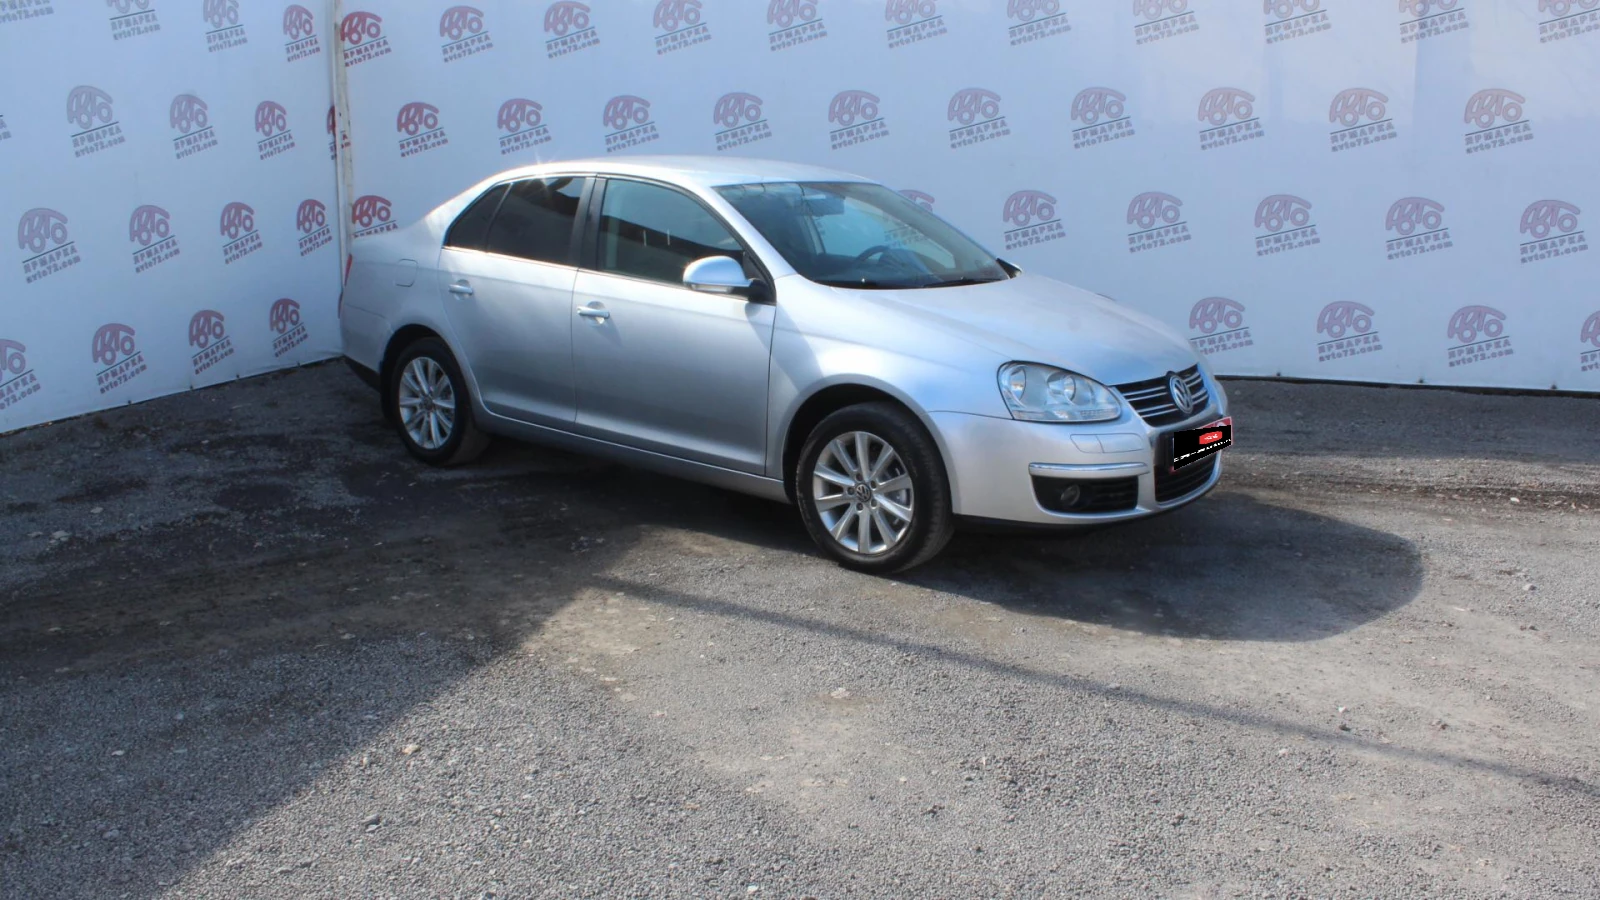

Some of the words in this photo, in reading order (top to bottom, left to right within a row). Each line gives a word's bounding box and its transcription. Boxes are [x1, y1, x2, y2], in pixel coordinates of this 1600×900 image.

[111, 13, 158, 31] ЯРМАРКА
[113, 24, 161, 41] avto72.com
[887, 18, 944, 41] ЯРМАРКА
[1009, 16, 1068, 38] ЯРМАРКА
[1135, 15, 1196, 37] ЯРМАРКА
[1265, 13, 1329, 36] ЯРМАРКА
[1400, 11, 1466, 35] ЯРМАРКА
[1401, 21, 1469, 43] avto72.com
[206, 28, 245, 44] ЯРМАРКА
[546, 29, 597, 51] ЯРМАРКА
[656, 25, 708, 47] ЯРМАРКА
[769, 22, 825, 44] ЯРМАРКА
[770, 31, 827, 51] avto72.com
[888, 27, 947, 49] avto72.com
[1010, 25, 1071, 46] avto72.com
[1136, 24, 1199, 45] avto72.com
[1266, 23, 1332, 45] avto72.com
[208, 37, 248, 53] avto72.com
[285, 38, 319, 54] ЯРМАРКА
[287, 46, 321, 62] avto72.com
[342, 39, 388, 60] ЯРМАРКА
[442, 34, 491, 55] ЯРМАРКА
[443, 42, 494, 63] avto72.com
[548, 38, 600, 59] avto72.com
[657, 34, 712, 55] avto72.com
[343, 47, 392, 68] avto72.com
[72, 125, 122, 148] ЯРМАРКА
[174, 129, 215, 150] ЯРМАРКА
[399, 130, 446, 150] ЯРМАРКА
[500, 127, 549, 148] ЯРМАРКА
[605, 124, 657, 145] ЯРМАРКА
[716, 122, 769, 144] ЯРМАРКА
[830, 121, 886, 142] ЯРМАРКА
[831, 130, 889, 150] avto72.com
[950, 119, 1007, 141] ЯРМАРКА
[950, 129, 1010, 149] avto72.com
[1073, 120, 1132, 141] ЯРМАРКА
[1074, 129, 1135, 149] avto72.com
[1200, 121, 1262, 142] ЯРМАРКА
[1201, 130, 1264, 150] avto72.com
[1330, 122, 1394, 144] ЯРМАРКА
[1464, 123, 1531, 146] ЯРМАРКА
[75, 136, 126, 158] avto72.com
[176, 139, 218, 159] avto72.com
[258, 133, 293, 152] ЯРМАРКА
[260, 141, 295, 160] avto72.com
[400, 138, 448, 157] avto72.com
[501, 135, 552, 155] avto72.com
[606, 133, 660, 153] avto72.com
[717, 131, 772, 151] avto72.com
[1331, 132, 1397, 152] avto72.com
[1465, 133, 1534, 154] avto72.com
[299, 228, 330, 249] ЯРМАРКА
[1005, 222, 1063, 242] ЯРМАРКА
[1005, 231, 1066, 250] avto72.com
[1128, 225, 1188, 245] ЯРМАРКА
[1256, 228, 1318, 248] ЯРМАРКА
[1386, 231, 1450, 252] ЯРМАРКА
[133, 239, 177, 265] ЯРМАРКА
[223, 233, 260, 256] ЯРМАРКА
[225, 241, 262, 264] avto72.com
[300, 235, 332, 257] avto72.com
[1129, 234, 1192, 254] avto72.com
[1256, 237, 1320, 256] avto72.com
[1387, 241, 1453, 260] avto72.com
[1520, 234, 1586, 255] ЯРМАРКА
[1520, 244, 1588, 264] avto72.com
[23, 245, 77, 274] ЯРМАРКА
[26, 255, 81, 284] avto72.com
[135, 248, 180, 274] avto72.com
[273, 326, 305, 349] ЯРМАРКА
[275, 333, 308, 357] avto72.com
[1318, 335, 1380, 354] ЯРМАРКА
[193, 340, 231, 367] ЯРМАРКА
[1319, 344, 1383, 362] avto72.com
[1448, 339, 1511, 359] ЯРМАРКА
[1449, 348, 1514, 367] avto72.com
[97, 355, 144, 386] ЯРМАРКА
[195, 348, 234, 375] avto72.com
[100, 364, 147, 394] avto72.com
